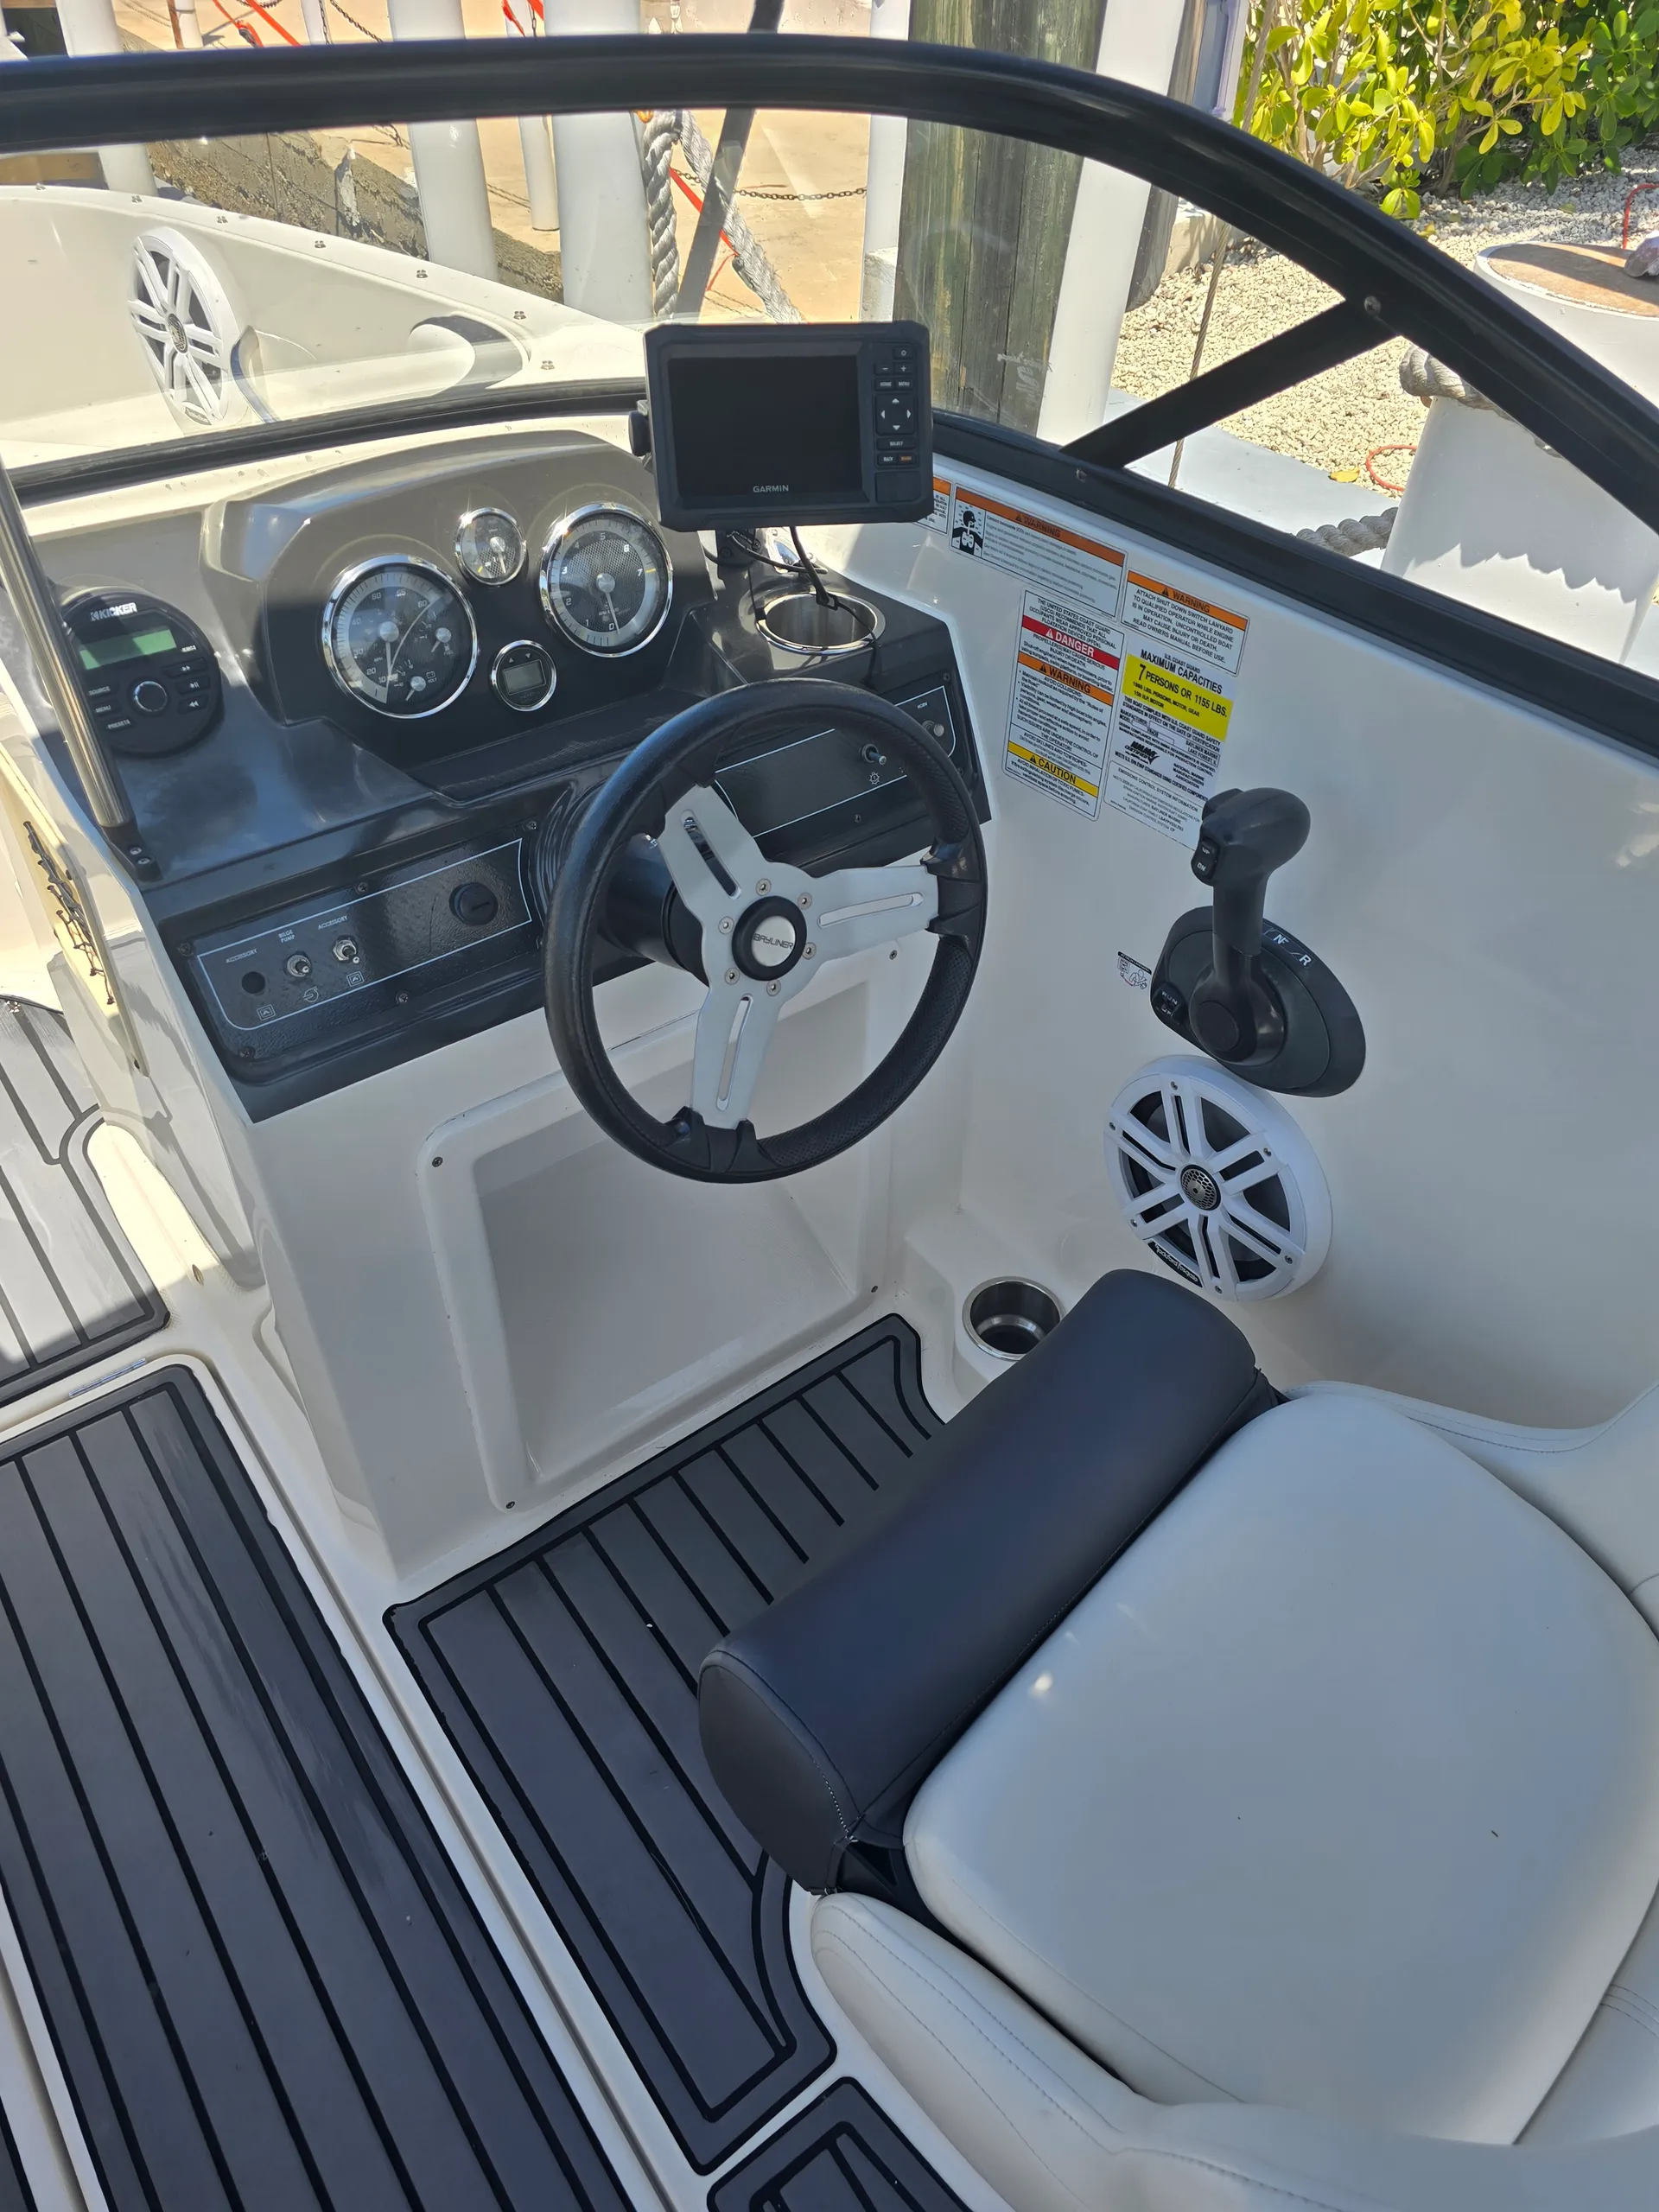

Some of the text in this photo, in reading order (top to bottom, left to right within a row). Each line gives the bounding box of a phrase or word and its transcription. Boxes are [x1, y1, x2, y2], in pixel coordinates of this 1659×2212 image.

[753, 485, 789, 493] GARMIN
[1023, 516, 1060, 537] WARNING
[99, 602, 137, 619] KICKER
[1135, 588, 1233, 634] ATTACH SHUT DOWN SWITCH LANYARD
[1172, 590, 1210, 613] WARNING
[1029, 606, 1116, 648] OCCUPANTS WEAR APPROVED PERSONAL
[1041, 617, 1066, 632] FLOATATION
[1067, 628, 1085, 641] DEVICES
[1046, 602, 1062, 613] UNITED
[1063, 609, 1078, 620] STATES
[1078, 616, 1094, 627] COAST
[1094, 623, 1110, 634] GUARD
[1055, 612, 1085, 629] RECOMMENDS
[1085, 625, 1097, 634] THAT
[1097, 630, 1106, 639] ALL
[1141, 598, 1166, 613] QUALIFIED
[1167, 609, 1195, 626] OPERATOR
[1196, 621, 1213, 633] WHILE
[1213, 629, 1234, 643] ENGINE
[1142, 613, 1153, 623] MAY
[1154, 619, 1171, 631] CAUSE
[1172, 626, 1189, 639] INJURY
[1190, 634, 1198, 643] OR
[1055, 631, 1094, 657] DANGER
[1133, 617, 1146, 627] READ
[1147, 623, 1169, 638] OWNERS
[1169, 633, 1191, 647] MANUAL
[1192, 643, 1212, 657] BEFORE
[1175, 620, 1217, 643] UNCONTROLLED
[1217, 639, 1232, 650] BOAT
[1140, 649, 1223, 695] MAXIMUM CAPACITIES
[1172, 657, 1185, 667] COAST
[1185, 663, 1200, 674] GUARD
[89, 686, 111, 696] SOURCE
[1049, 666, 1090, 694] WARNING
[1137, 663, 1228, 717] 7 PERSONS OR 1155 LBS.
[107, 719, 130, 729] PRESETS
[1122, 701, 1143, 715] STANDARDS
[1148, 714, 1161, 724] EFFECT
[1176, 727, 1185, 735] DATE
[1192, 734, 1220, 752] CERTIFICATION
[1132, 700, 1142, 709] BOAT
[1142, 704, 1160, 717] COMPLIES
[1179, 722, 1191, 732] COAST
[1192, 728, 1205, 739] GUARD
[1205, 735, 1220, 746] SAFETY
[1187, 747, 1197, 755] LAKE
[1038, 757, 1076, 784] CAUTION
[1197, 861, 1206, 871] DN
[318, 915, 348, 930] ACCESSORY
[281, 934, 296, 943] PUMP
[753, 933, 793, 950] BAYLINER
[226, 949, 257, 963] ACCESSORY
[1299, 954, 1312, 966] R
[1161, 991, 1178, 1005] RUN
